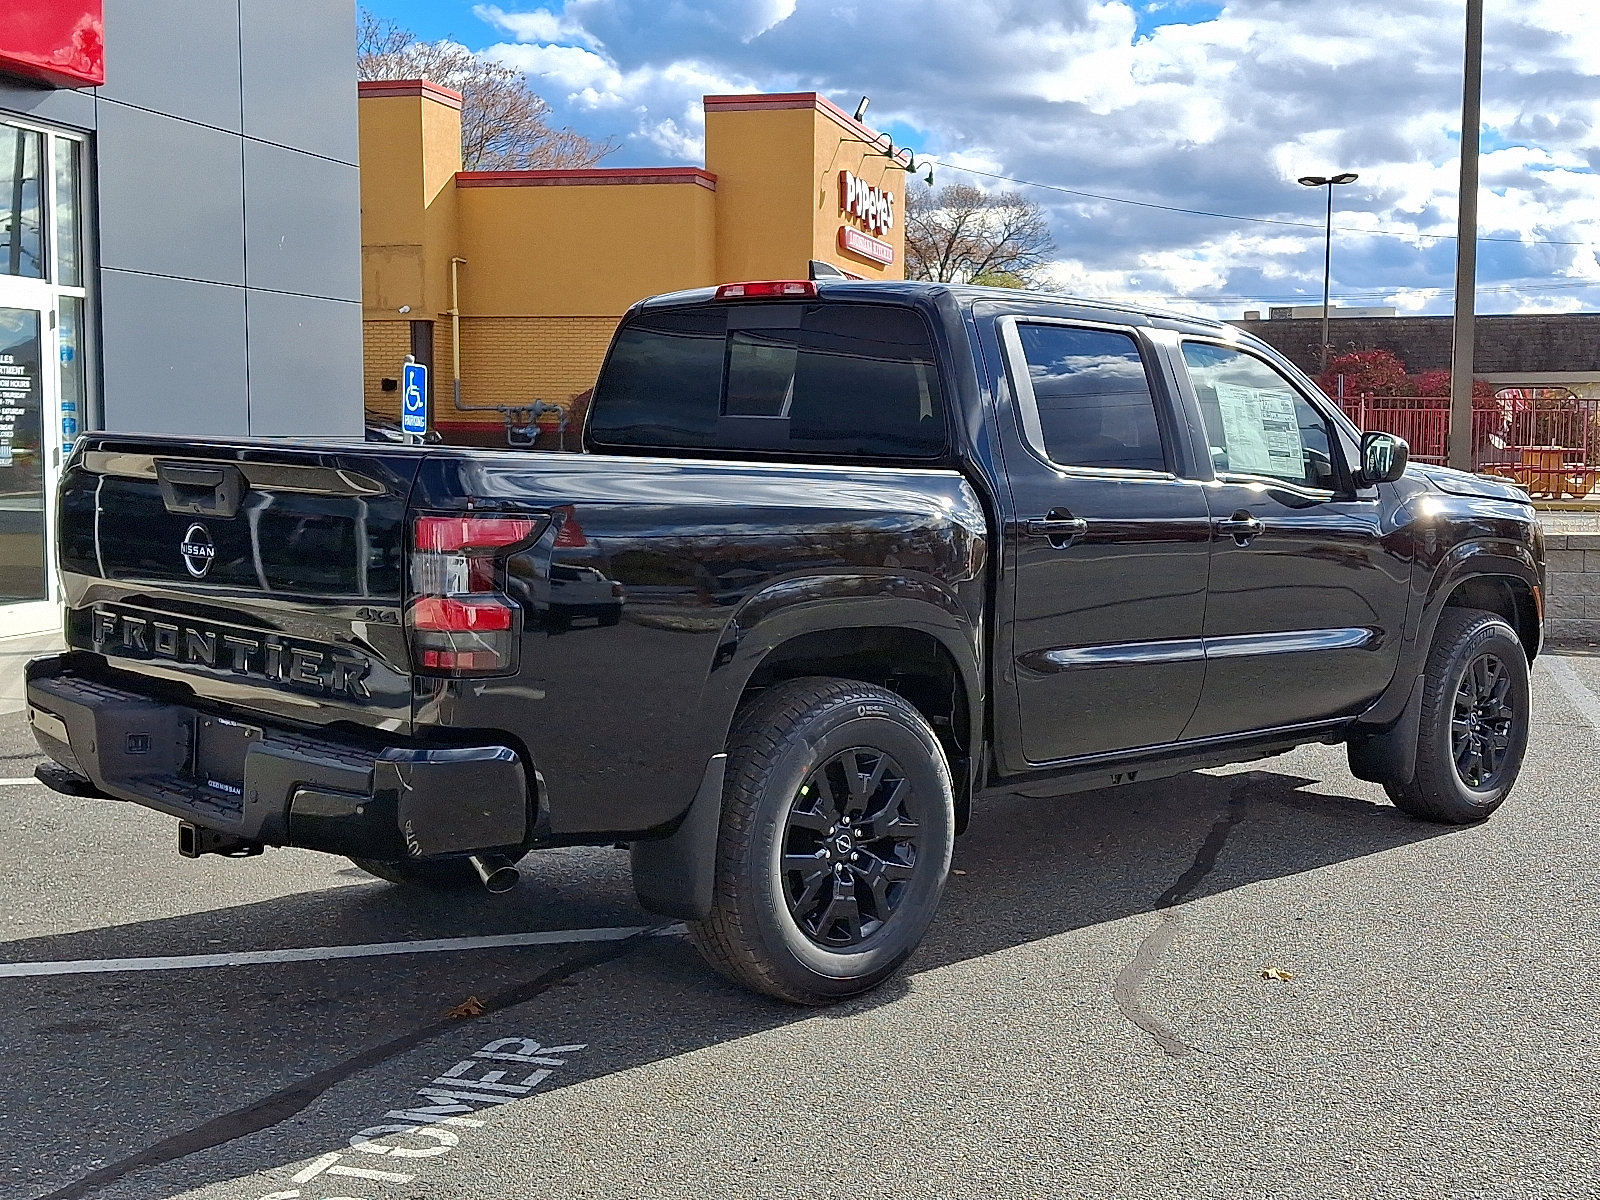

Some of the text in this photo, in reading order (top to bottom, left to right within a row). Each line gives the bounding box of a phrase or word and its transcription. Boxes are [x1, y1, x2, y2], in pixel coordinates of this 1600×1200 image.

[180, 541, 215, 558] NISSAN
[91, 606, 371, 699] FRONTIER
[259, 1036, 589, 1200] TOMER
